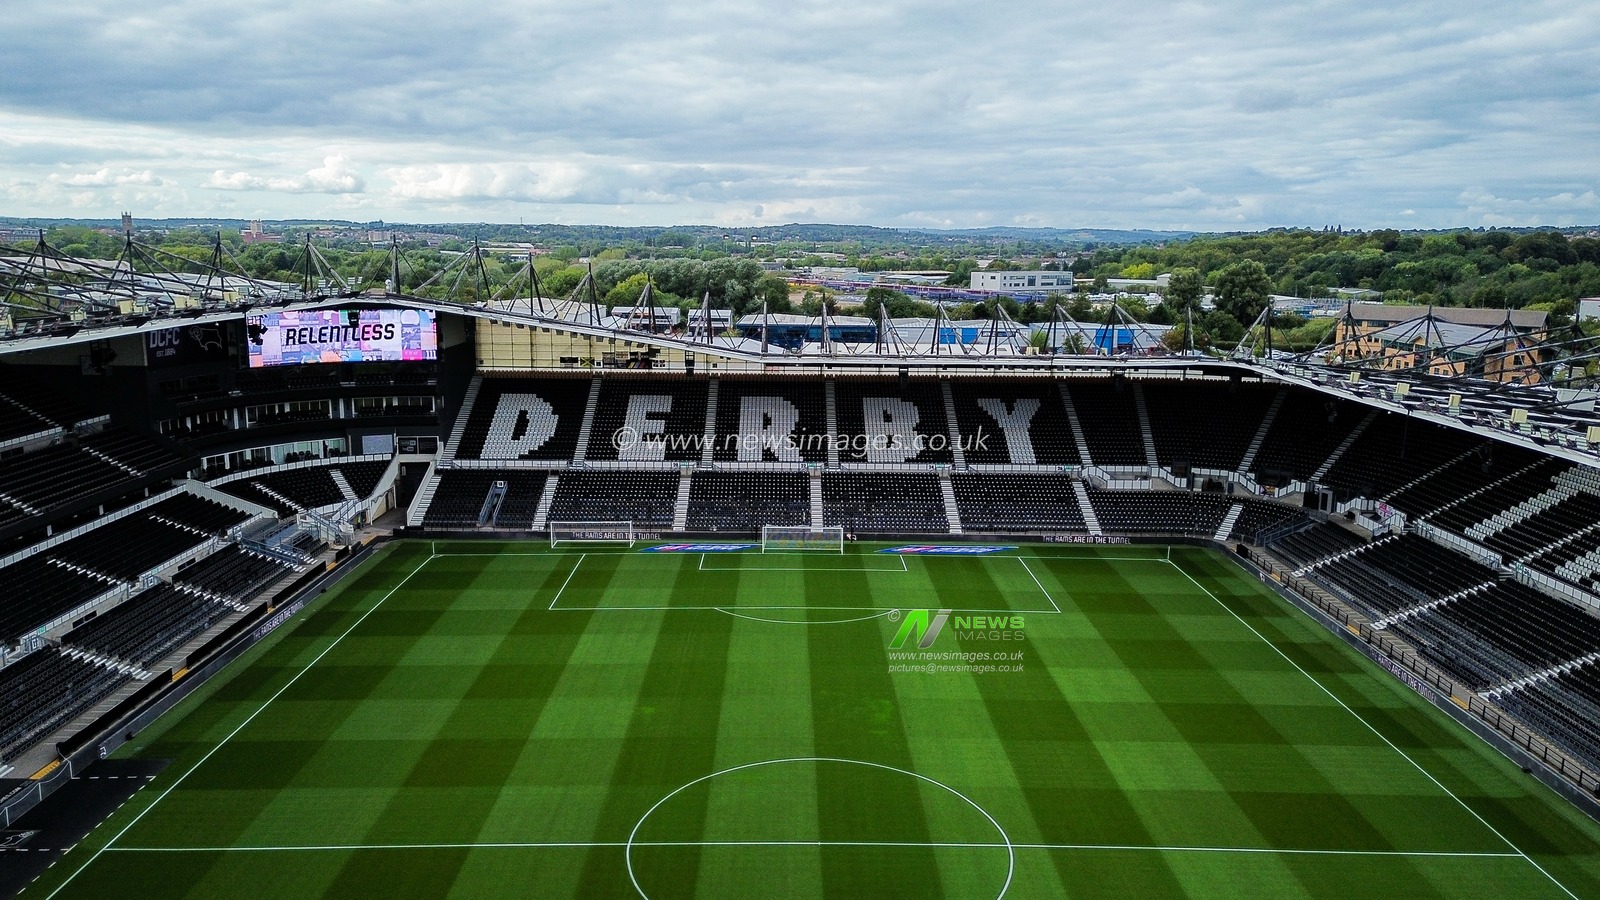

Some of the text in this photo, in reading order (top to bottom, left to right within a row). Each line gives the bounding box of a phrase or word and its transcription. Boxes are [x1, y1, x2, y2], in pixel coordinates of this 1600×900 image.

[150, 327, 180, 348] DCFC
[286, 323, 395, 346] RELENTLESS
[480, 393, 1041, 464] DERBY
